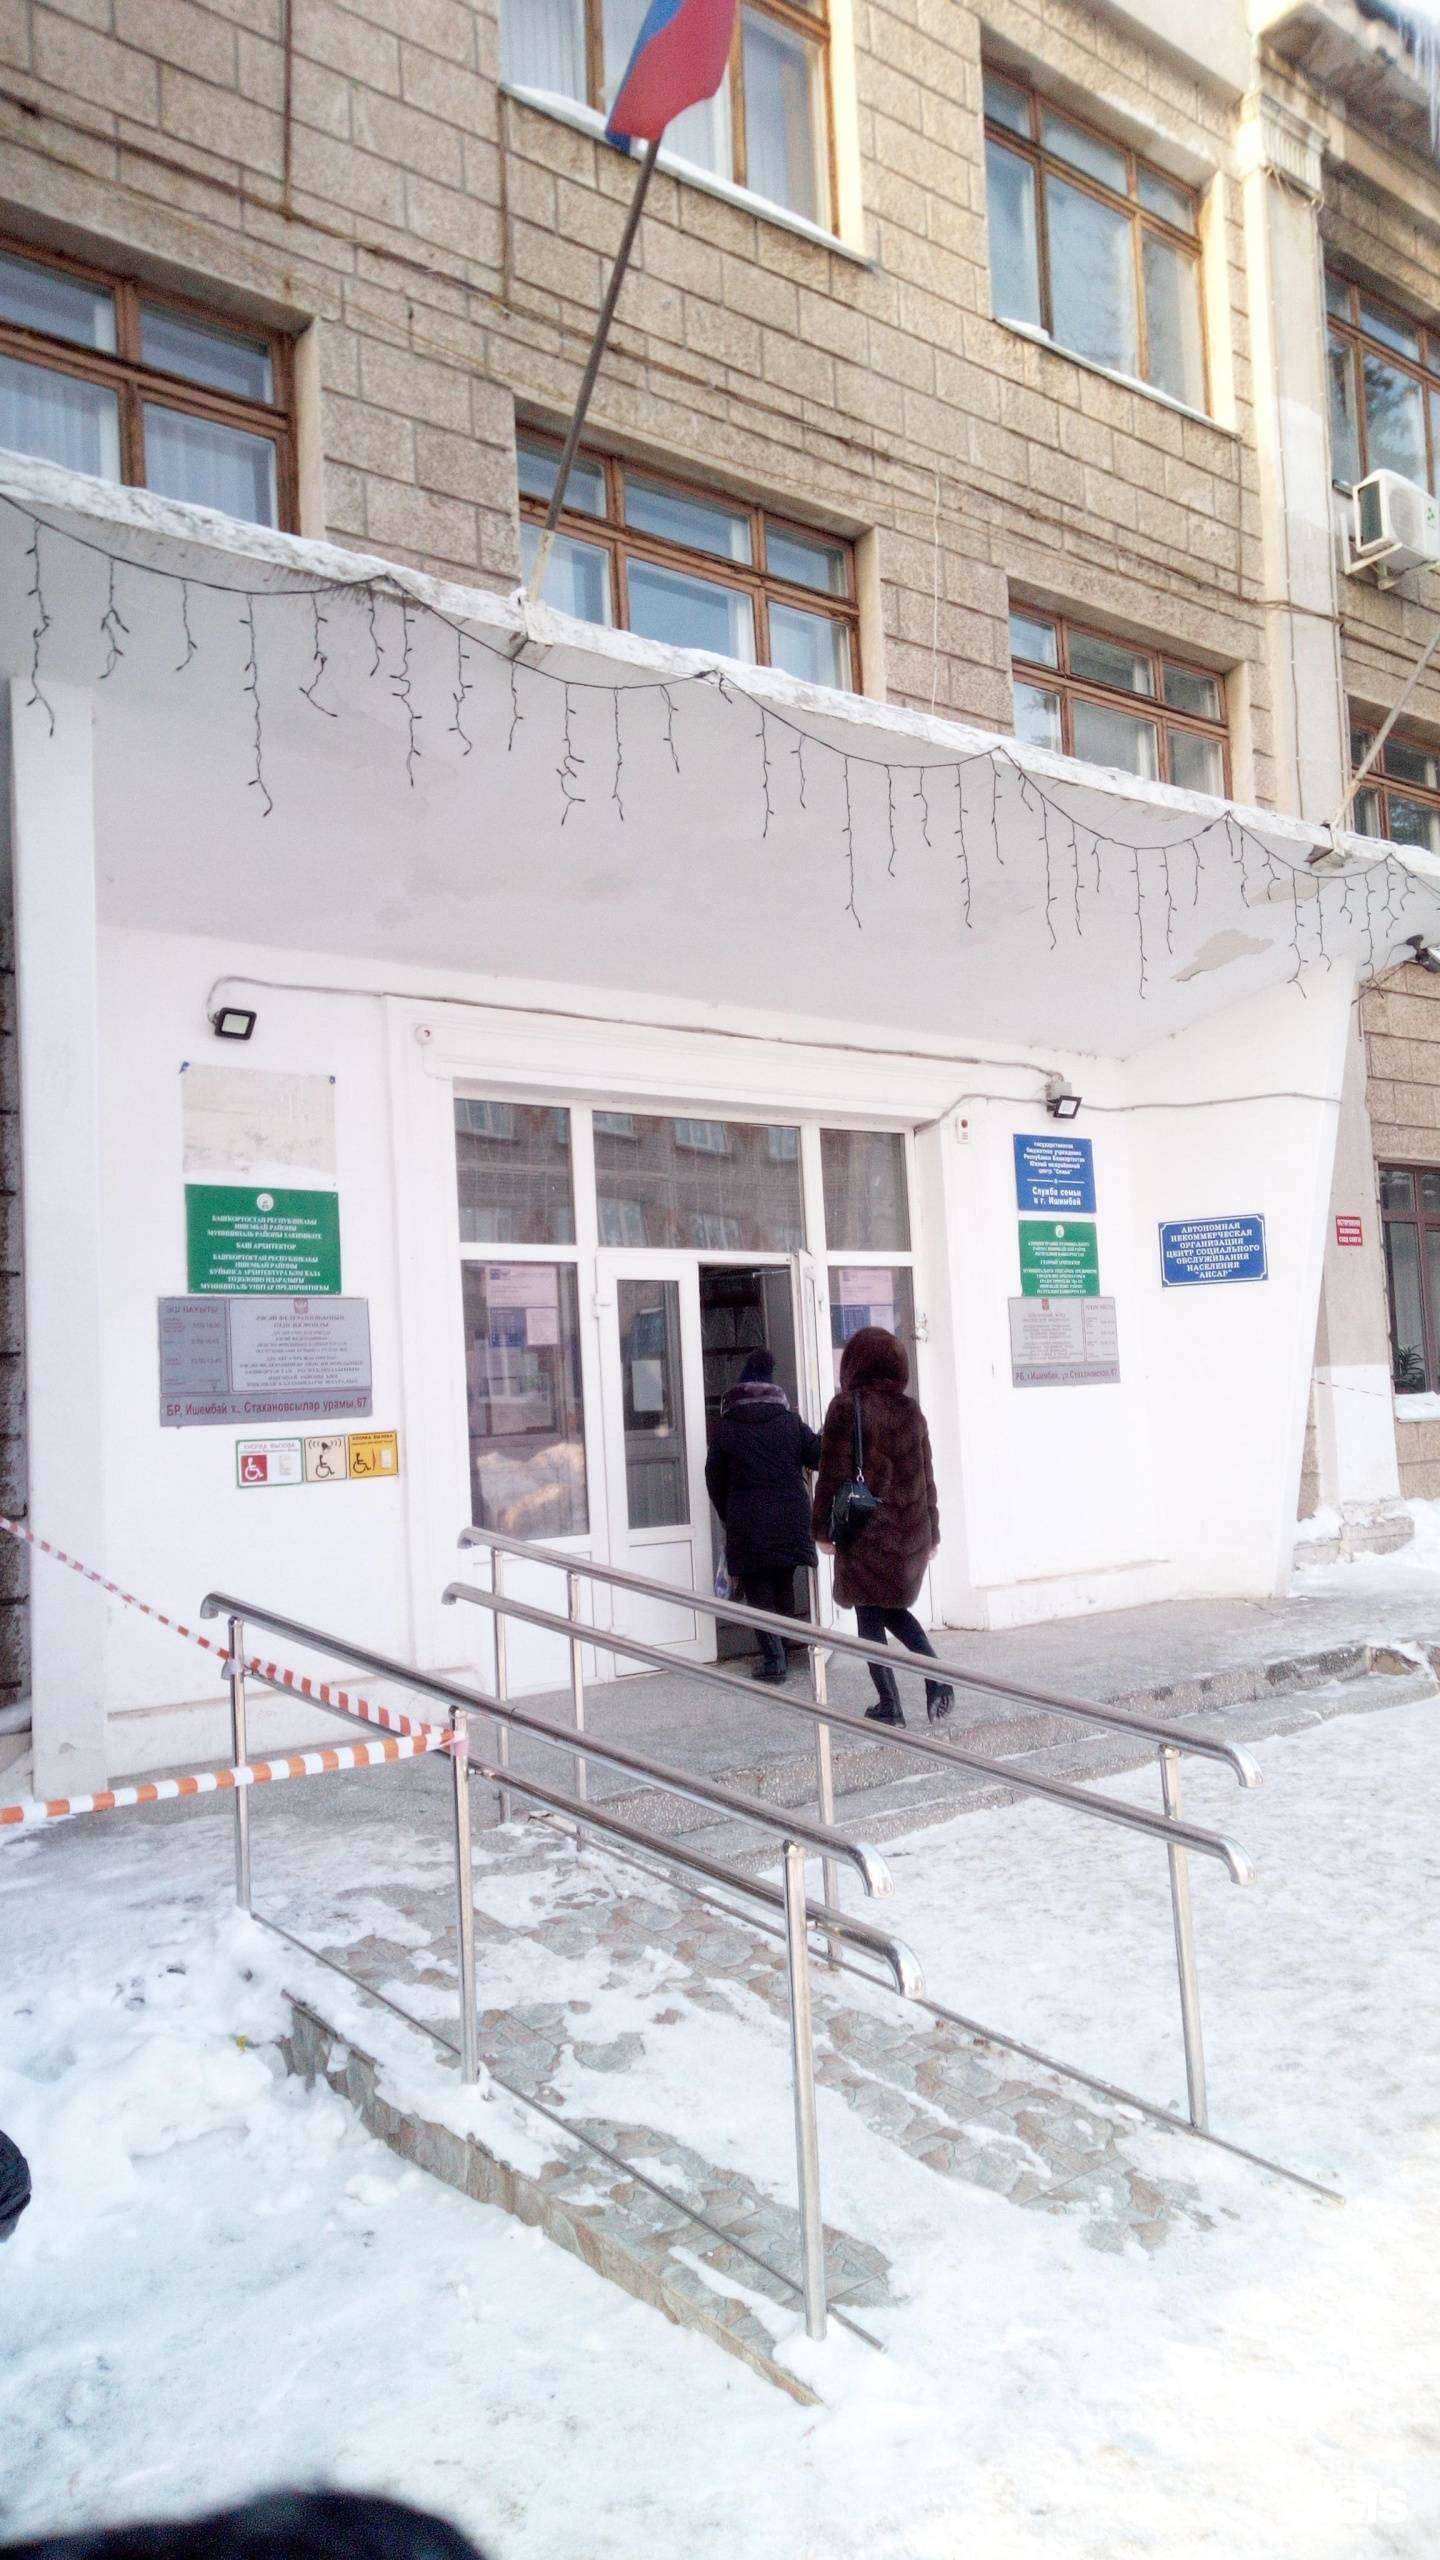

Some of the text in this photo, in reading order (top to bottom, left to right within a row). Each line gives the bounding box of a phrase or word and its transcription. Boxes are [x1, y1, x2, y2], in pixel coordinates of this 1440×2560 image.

[1181, 1222, 1240, 1234] АВТОНОМНАЯ
[1171, 1229, 1252, 1242] НЕКОММЕРЧЕСКАЯ
[1180, 1238, 1244, 1249] ОРГАНИЗАЦИЯ
[1166, 1244, 1259, 1258] ЦЕНТР СОЦИАЛЬНОГО
[1176, 1253, 1249, 1264] ОБСЛУЖИВАНИЯ
[1187, 1262, 1240, 1272] НАСЕЛЕНИЯ
[244, 1400, 319, 1414] Стахановсылар
